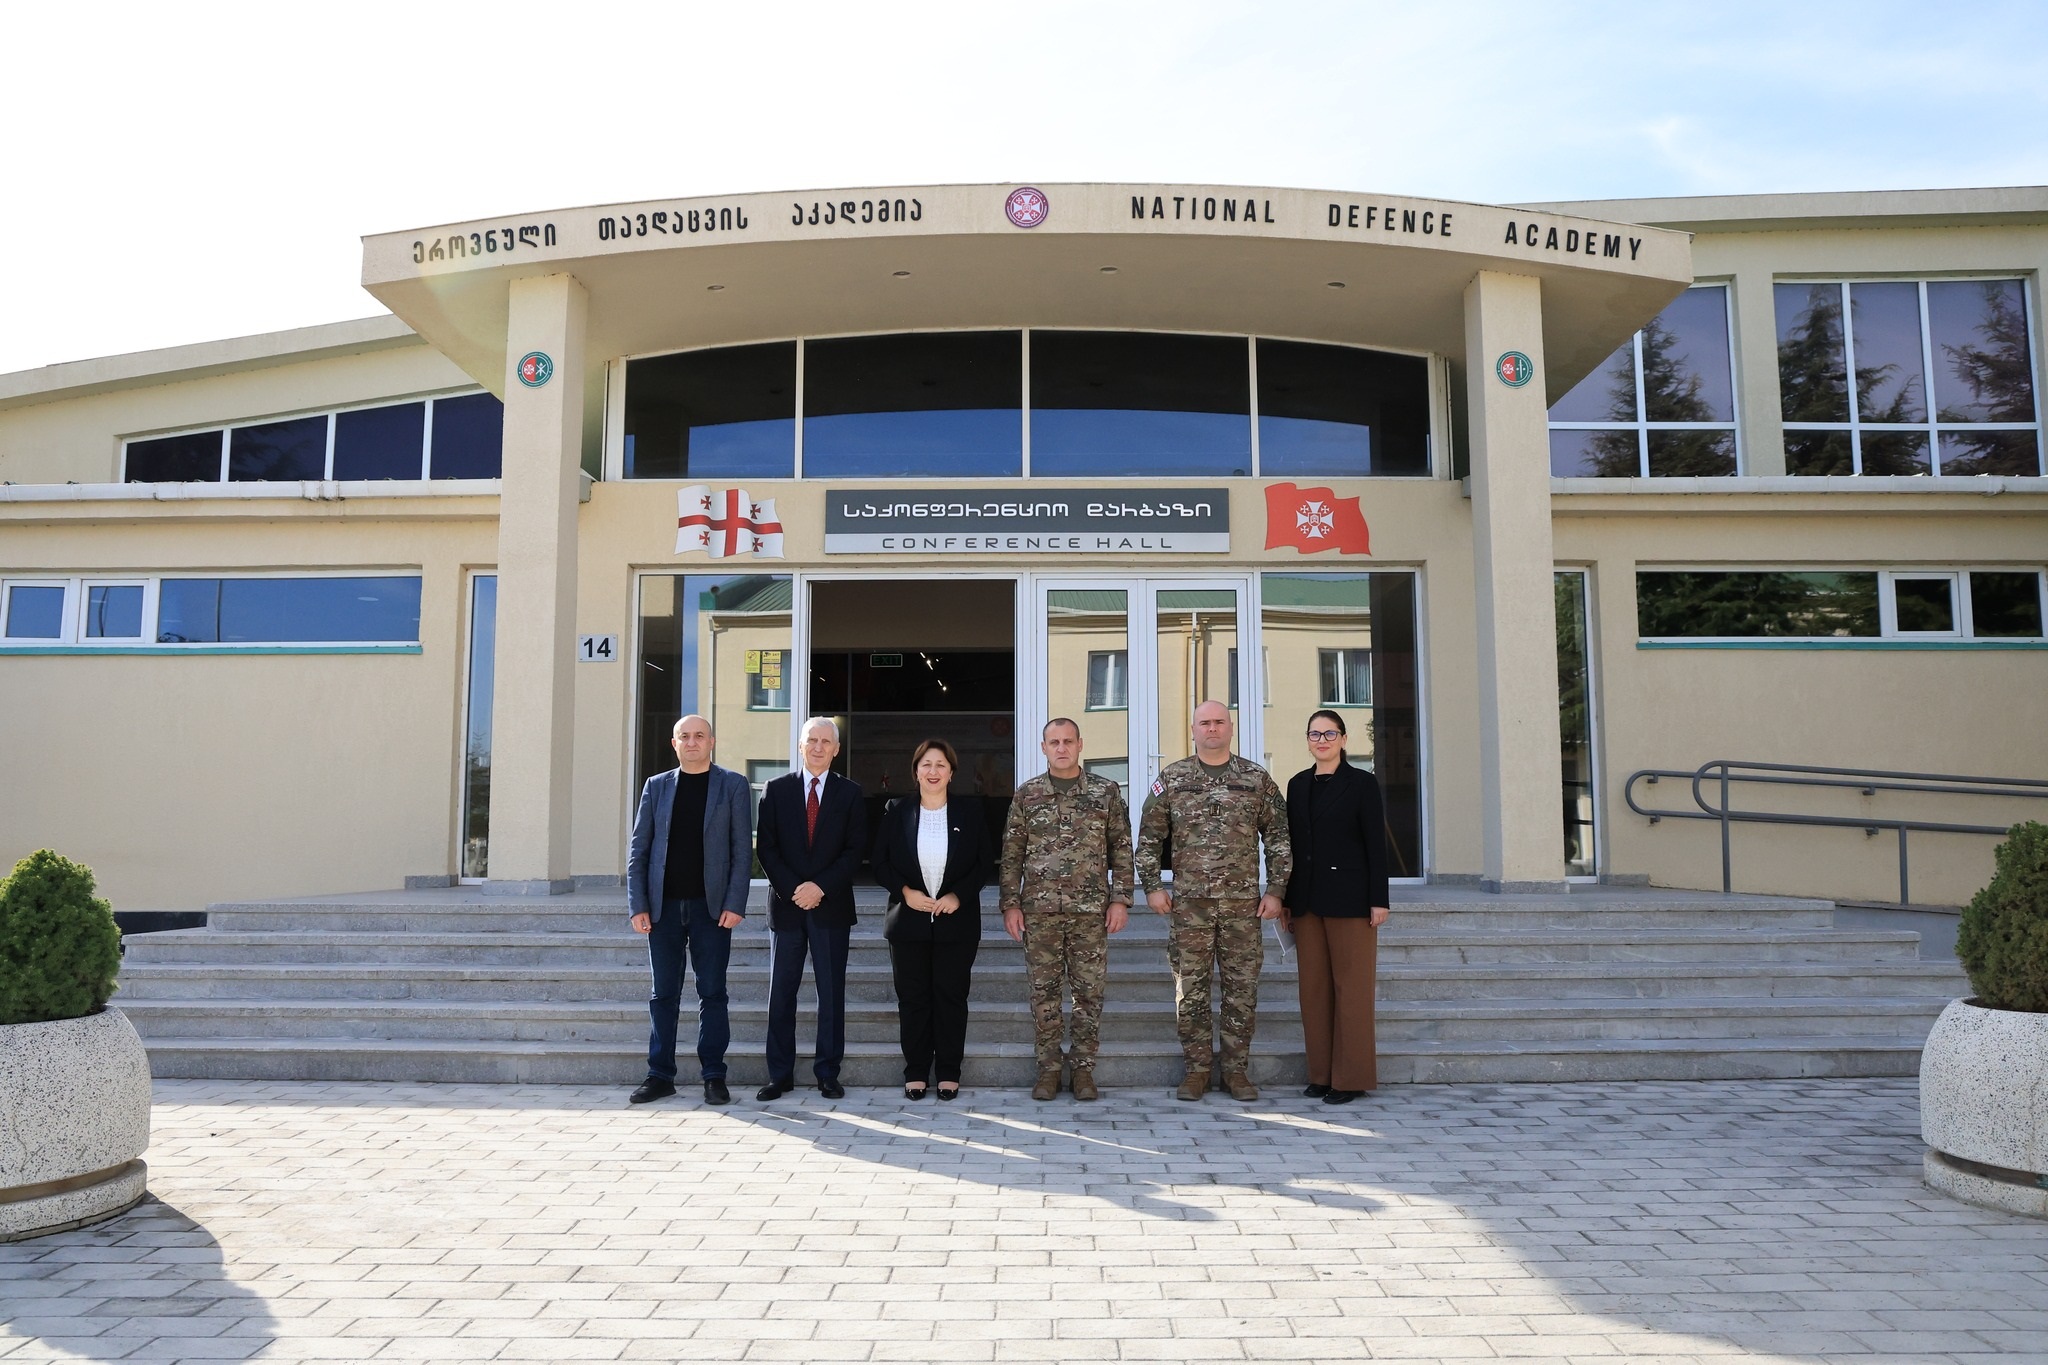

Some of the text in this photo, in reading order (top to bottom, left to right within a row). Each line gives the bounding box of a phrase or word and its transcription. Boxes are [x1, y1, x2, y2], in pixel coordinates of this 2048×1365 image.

[412, 198, 922, 264] ეროვნული თავდაცვის აკადემია
[1131, 196, 1642, 261] NATIONAL DEFENCE ACADEMY
[843, 503, 1211, 518] საკონფერენციო დარბაზი
[882, 537, 1172, 549] CONFERENCE HALL
[583, 637, 612, 658] 14
[873, 656, 900, 665] EXIT
